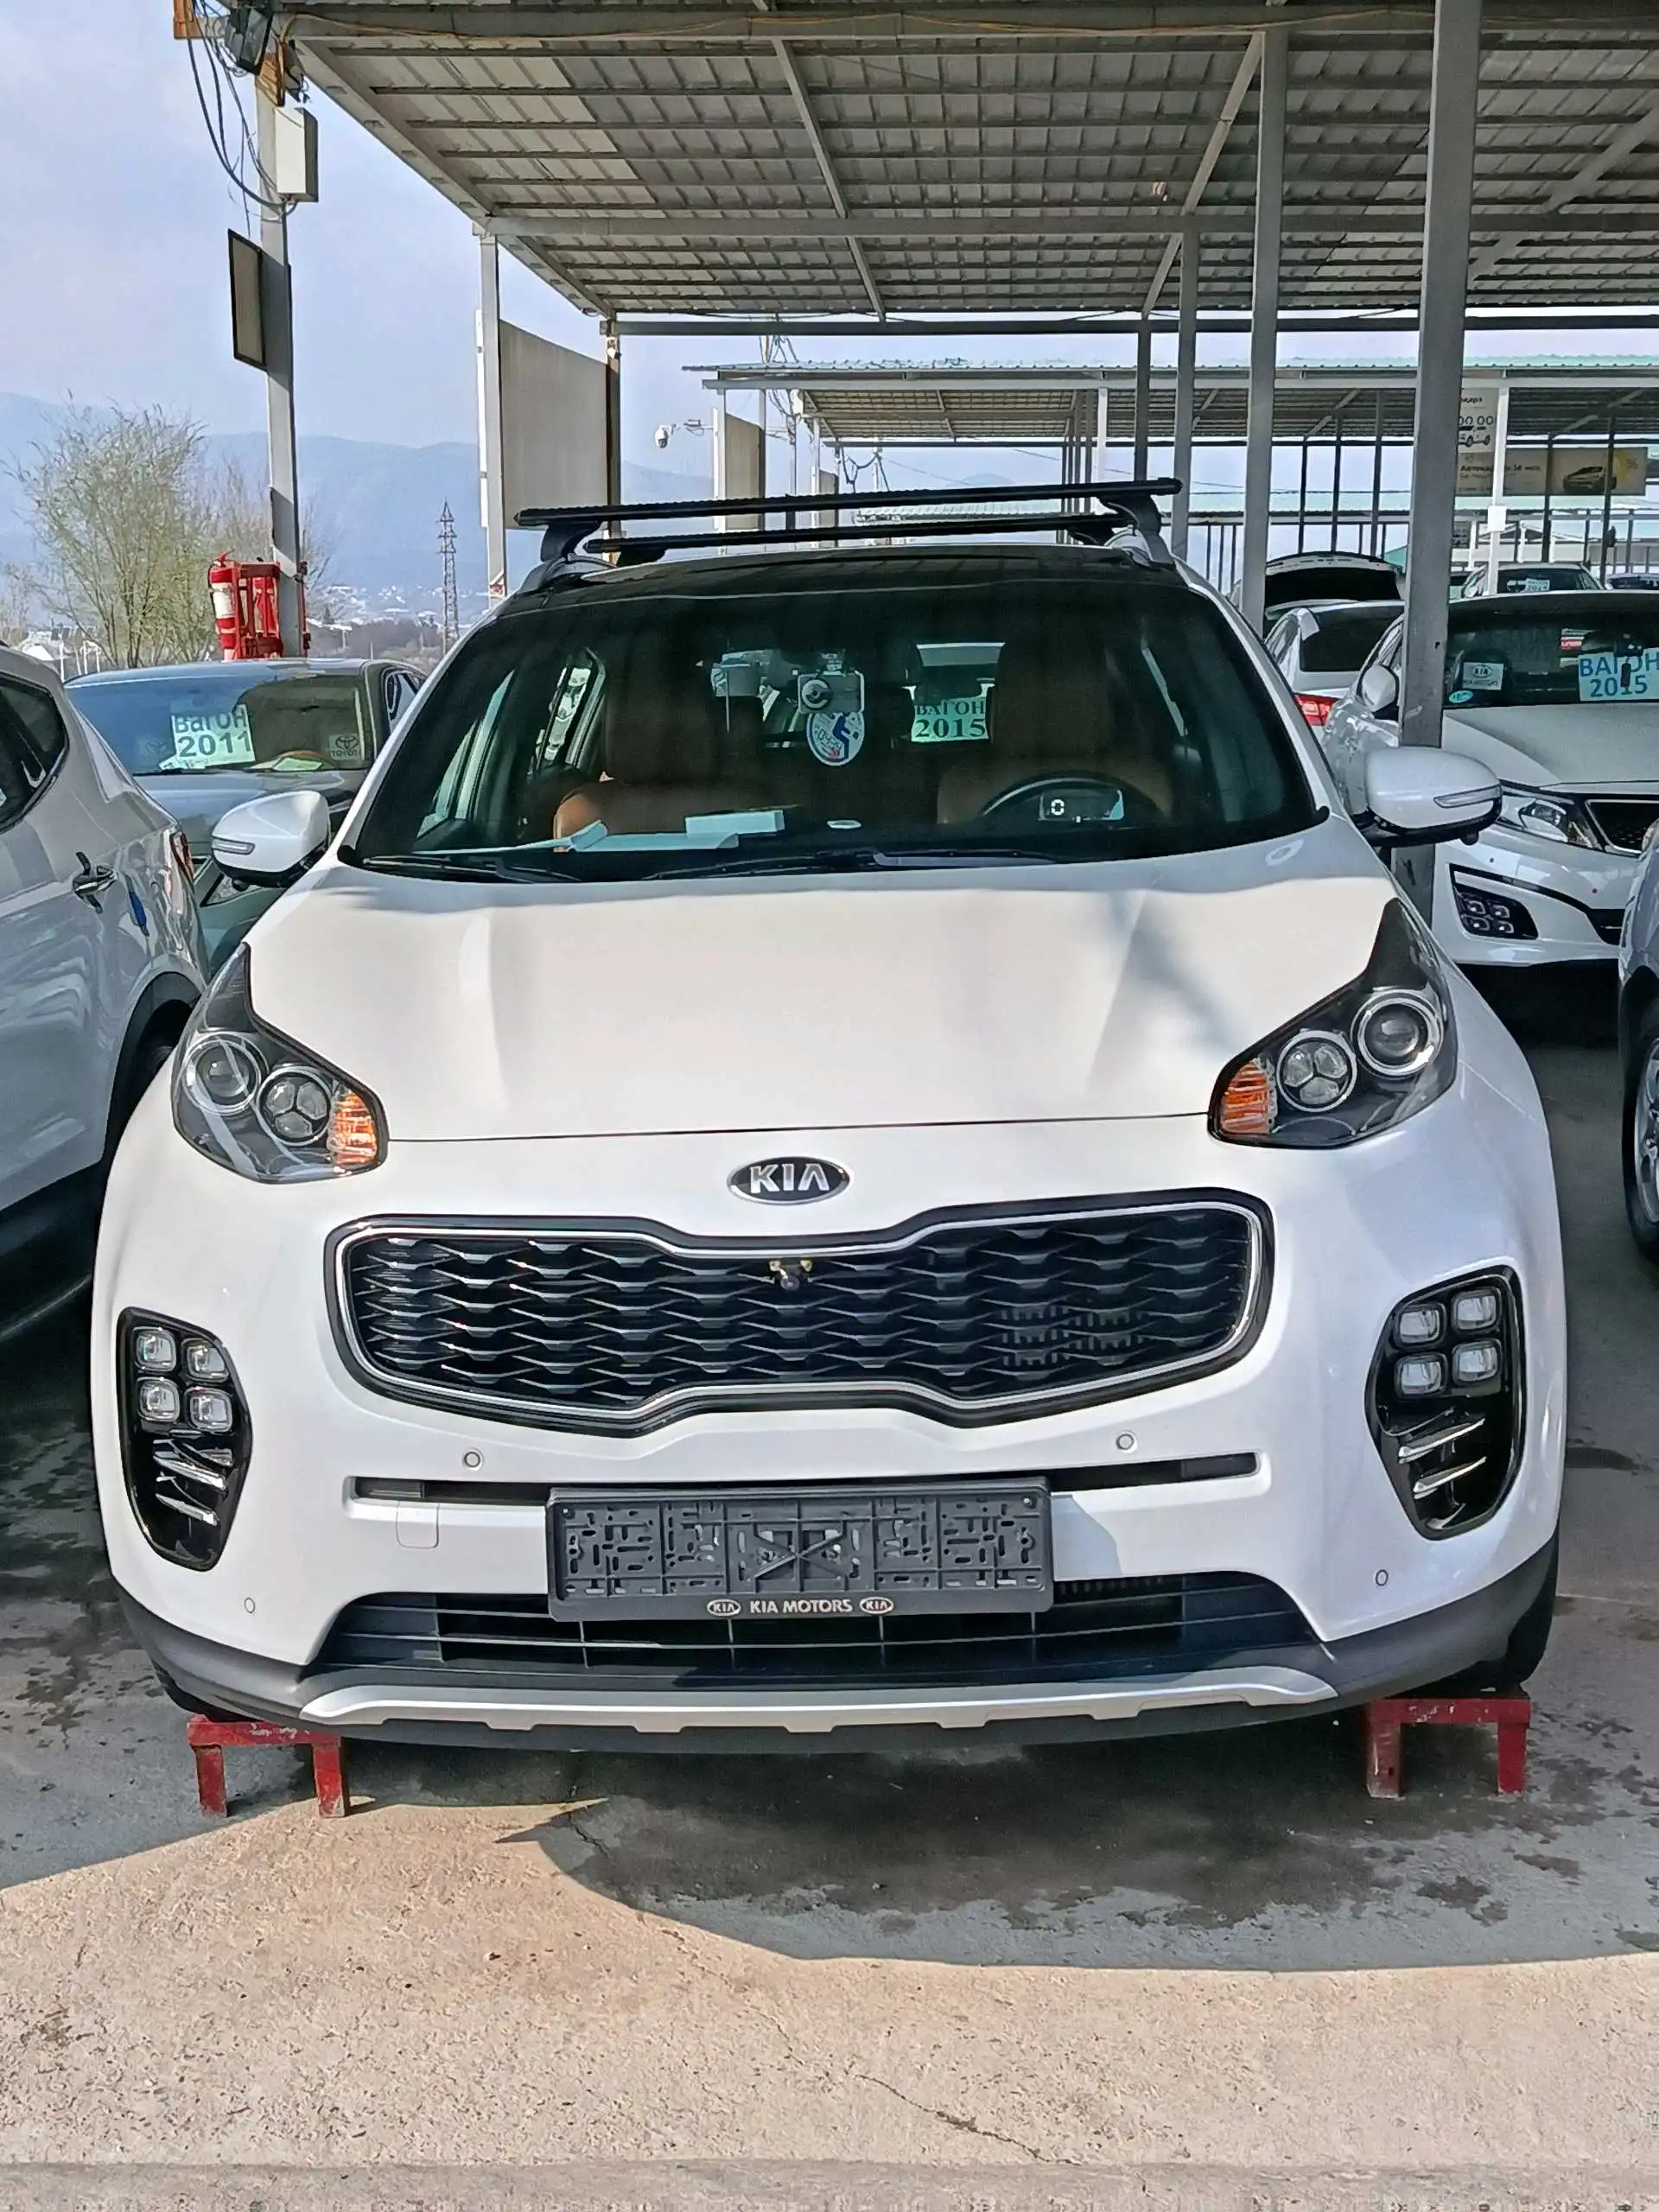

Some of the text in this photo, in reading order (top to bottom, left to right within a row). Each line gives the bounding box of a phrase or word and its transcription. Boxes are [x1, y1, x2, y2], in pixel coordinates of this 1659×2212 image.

[915, 719, 986, 738] 2015
[178, 730, 251, 757] 2011
[749, 1163, 830, 1194] KIA
[713, 1599, 887, 1614] KIA KIA MOTORS KIA
